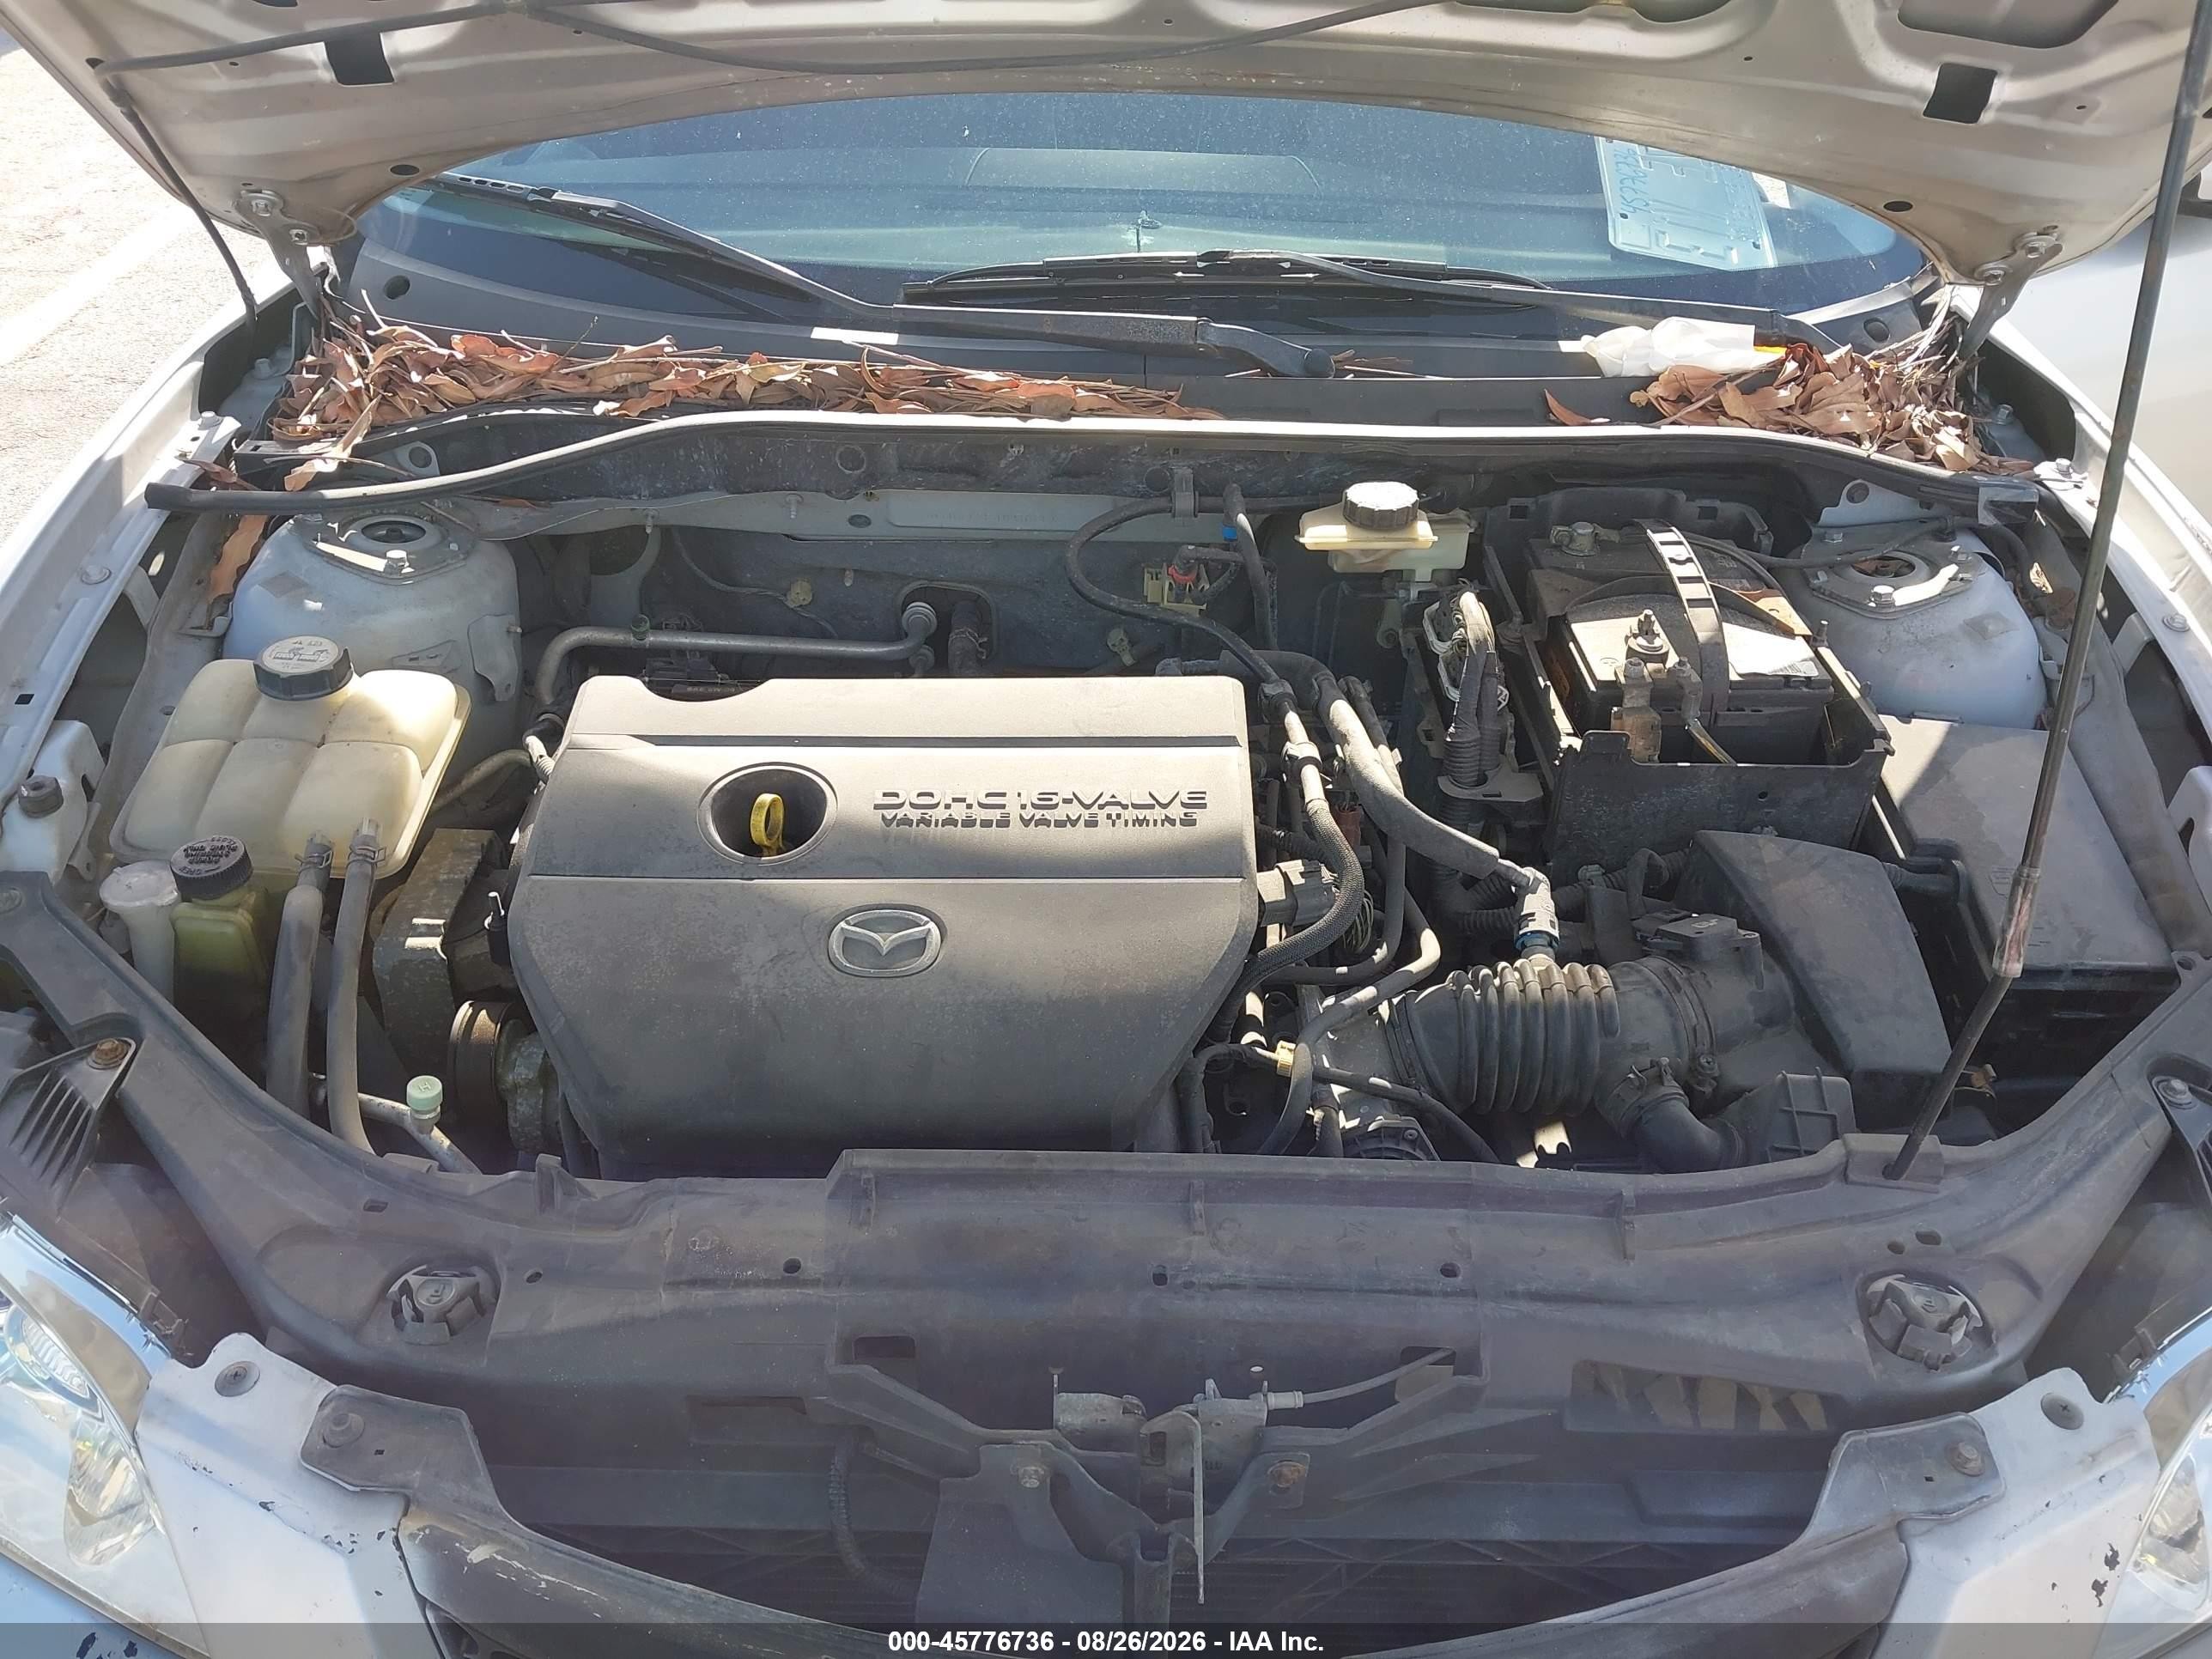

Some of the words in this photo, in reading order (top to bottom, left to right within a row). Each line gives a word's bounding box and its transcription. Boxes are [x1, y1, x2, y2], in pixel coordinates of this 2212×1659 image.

[873, 789, 1008, 810] DOHC
[1017, 789, 1208, 810] 16-VALVE
[880, 811, 1012, 829] VARIABLE
[1018, 811, 1100, 829] VALVE
[1106, 811, 1198, 828] TIMING
